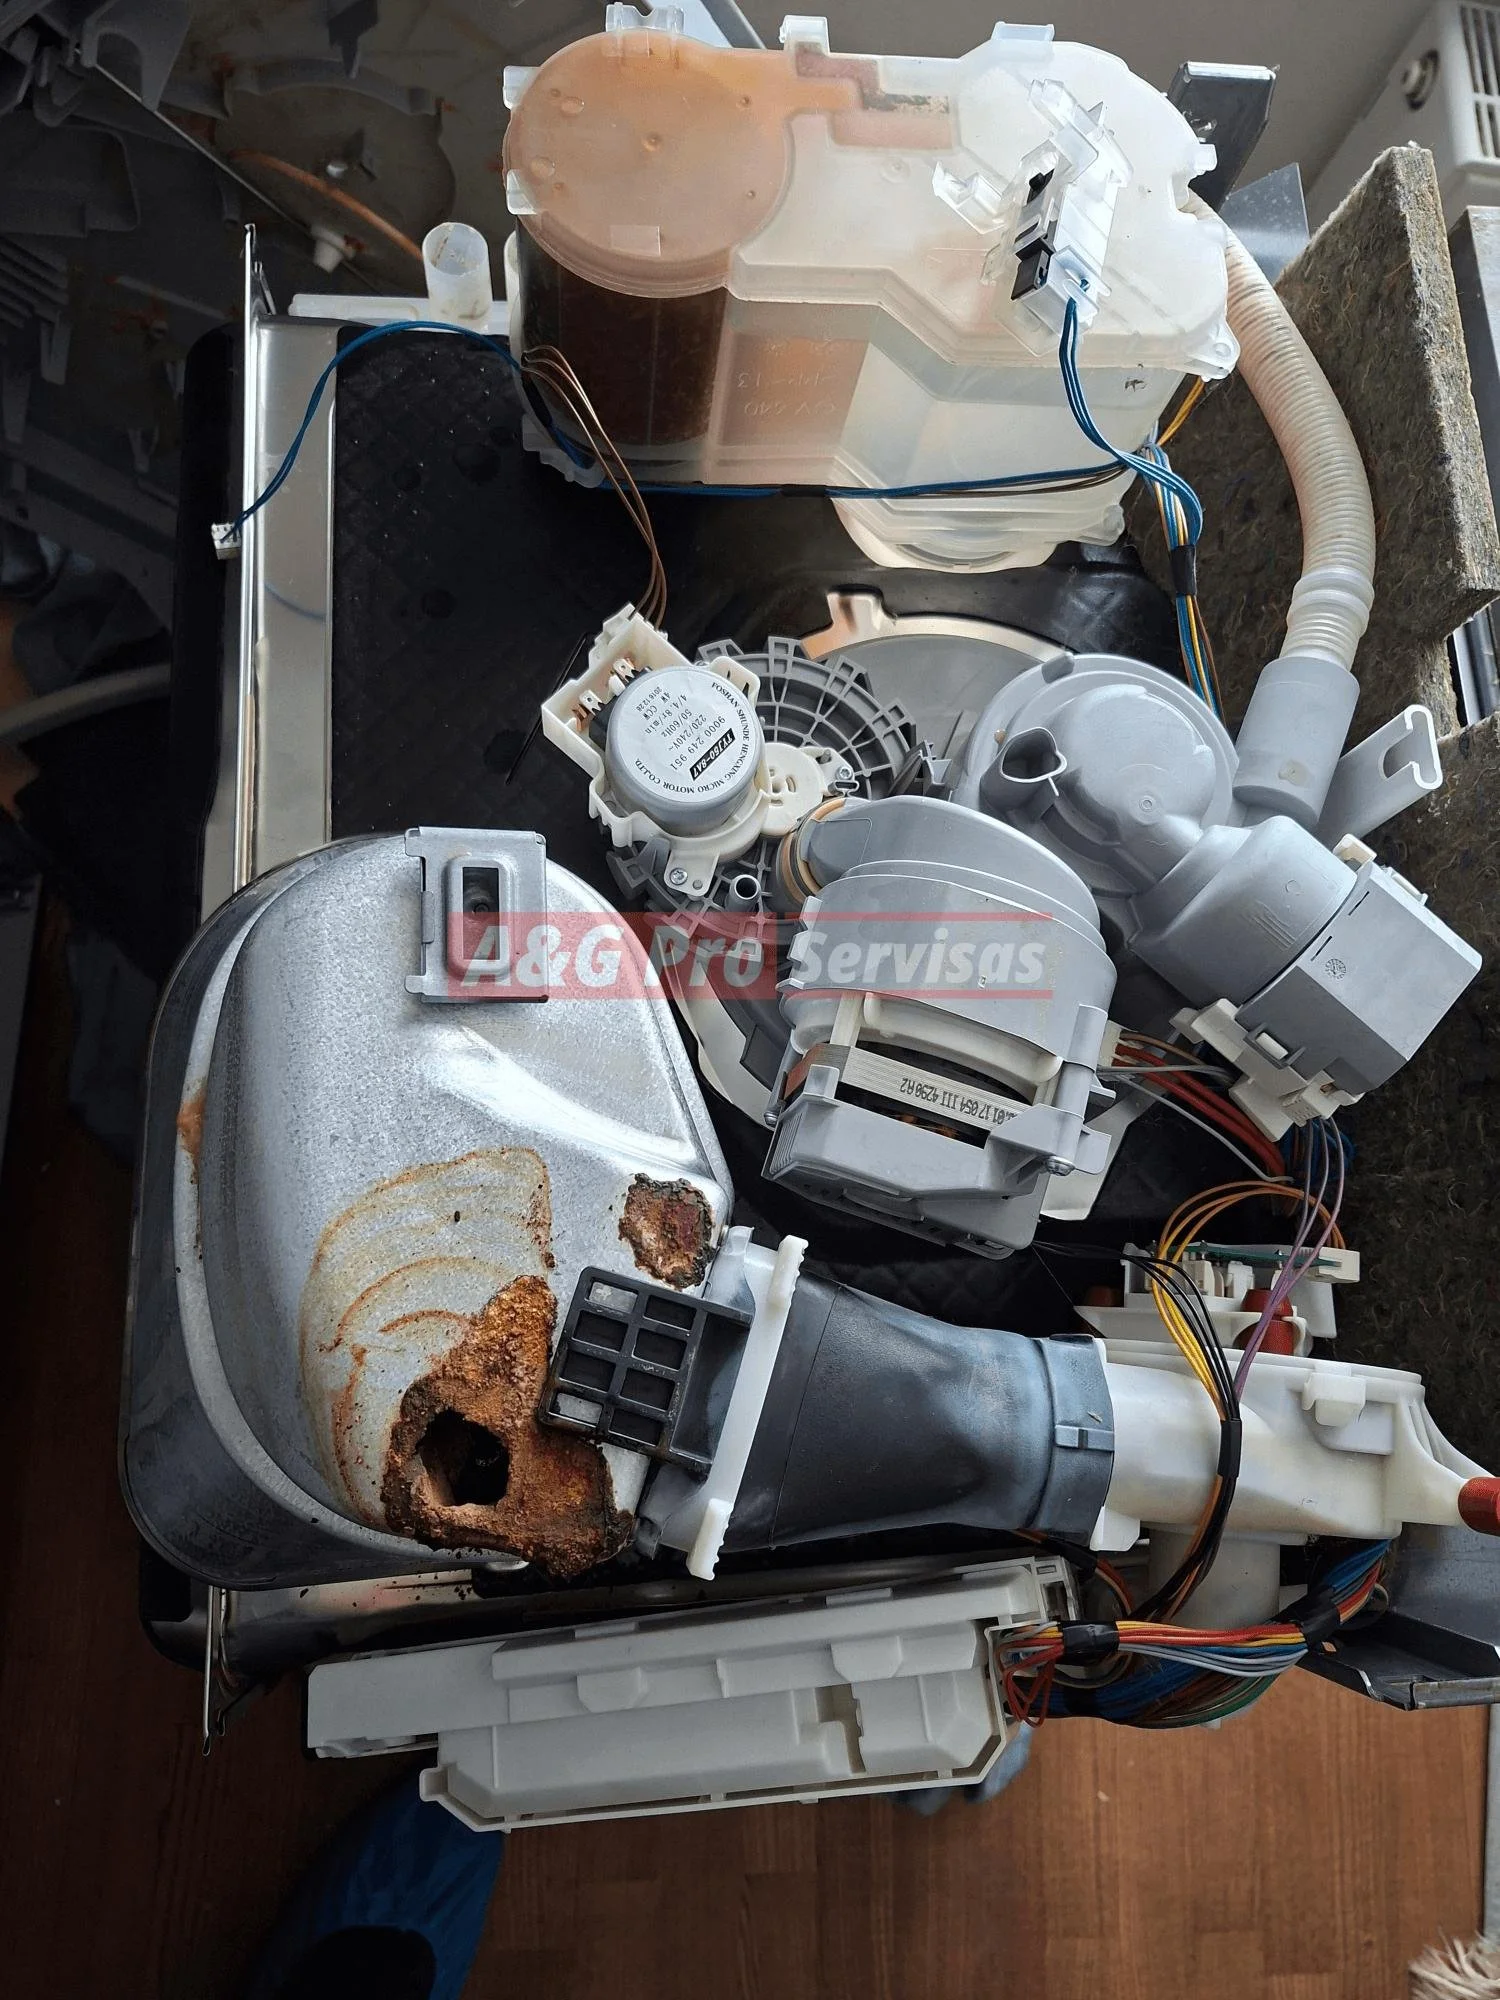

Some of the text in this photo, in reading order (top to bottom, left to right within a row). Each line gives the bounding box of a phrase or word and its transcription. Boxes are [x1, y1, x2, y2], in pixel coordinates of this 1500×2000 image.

[643, 692, 671, 721] 4W CCW
[712, 682, 739, 708] FOSHAN
[662, 709, 692, 738] 50/60Hz
[737, 709, 750, 741] SHUNDE
[670, 716, 726, 770] 9000 249 951
[724, 743, 749, 780] HENGXING
[663, 782, 695, 793] MOTOR
[698, 776, 725, 792] MICRO
[915, 1083, 938, 1102] 4290
